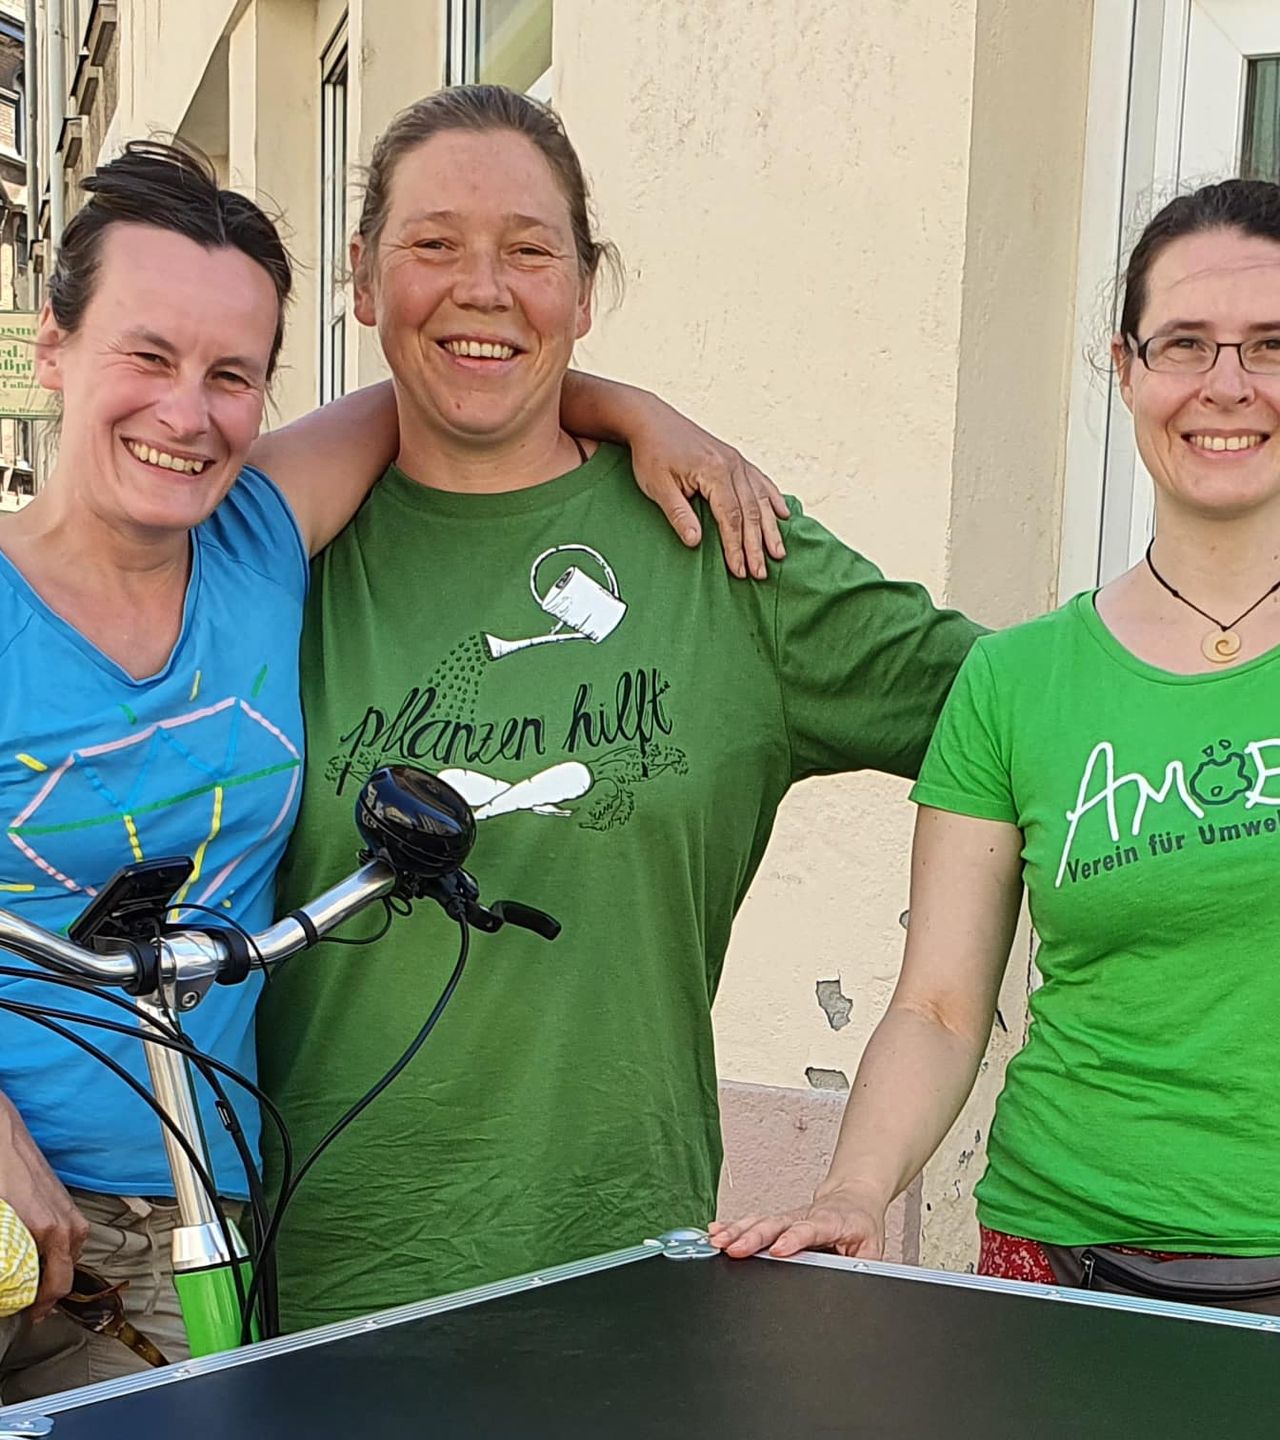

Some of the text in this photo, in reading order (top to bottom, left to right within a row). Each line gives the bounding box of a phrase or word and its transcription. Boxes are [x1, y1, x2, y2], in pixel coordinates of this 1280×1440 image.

[564, 668, 672, 778] hilft
[1066, 846, 1140, 884] Verein
[1148, 831, 1186, 858] für
